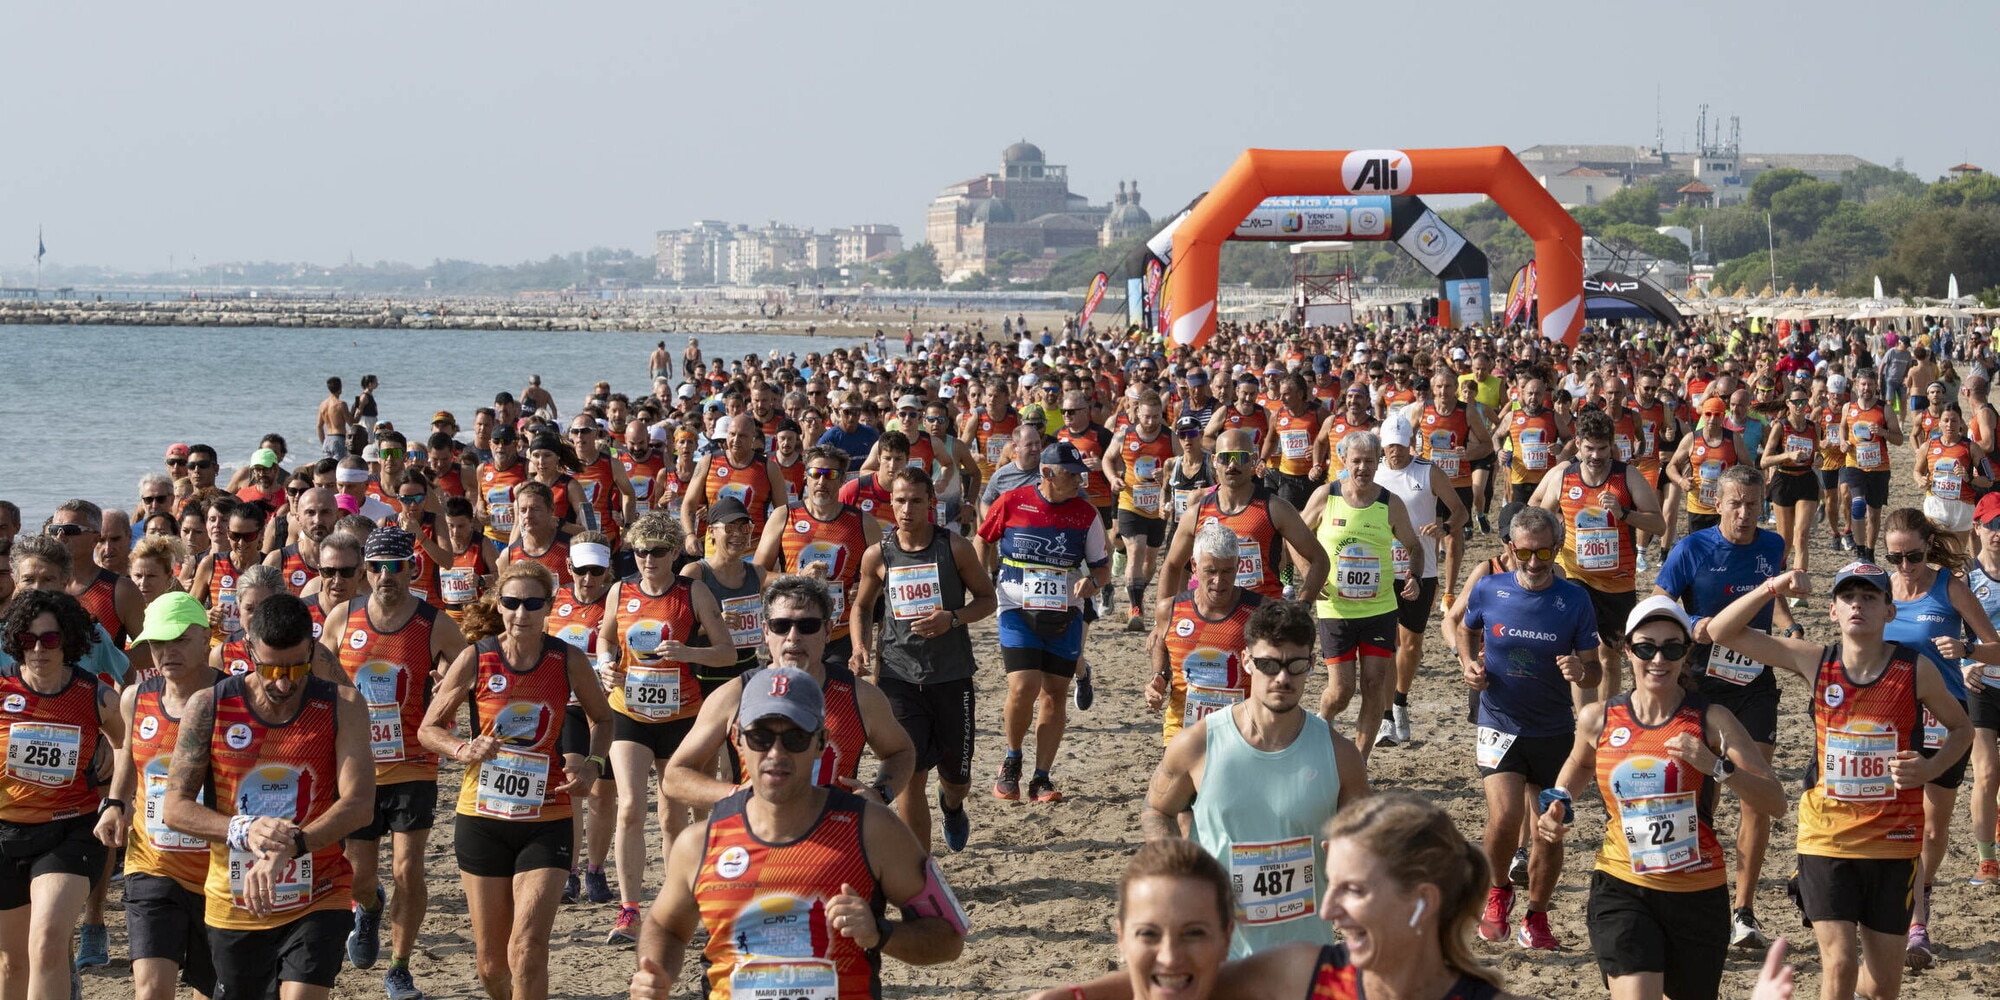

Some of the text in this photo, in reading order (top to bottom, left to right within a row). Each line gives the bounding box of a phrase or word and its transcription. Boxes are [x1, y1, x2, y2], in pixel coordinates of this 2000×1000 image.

[1583, 280, 1639, 292] CMP
[1286, 439, 1304, 449] 1228
[1527, 451, 1544, 461] 1719
[1937, 481, 1956, 491] 1535
[1139, 495, 1158, 505] 1072
[1334, 537, 1358, 556] VENICE
[1584, 542, 1610, 556] 2061
[1347, 571, 1370, 585] 602
[898, 582, 932, 601] 1849
[1034, 581, 1057, 596] 213
[1508, 628, 1558, 642] CARRARO
[768, 675, 790, 697] B
[638, 686, 667, 704] 329
[369, 724, 391, 742] 34
[24, 745, 62, 767] 258
[1838, 755, 1884, 778] 1186
[494, 773, 530, 798] 409
[1862, 785, 1885, 793] CMP
[1648, 820, 1675, 846] 22
[1259, 863, 1280, 872] STEVEN
[1253, 867, 1296, 897] 487
[1279, 901, 1303, 913] CMP
[763, 915, 798, 925] CMP
[768, 934, 797, 945] LIDO
[736, 971, 767, 981] CMP
[755, 987, 805, 997] MARIO FILIPPO
